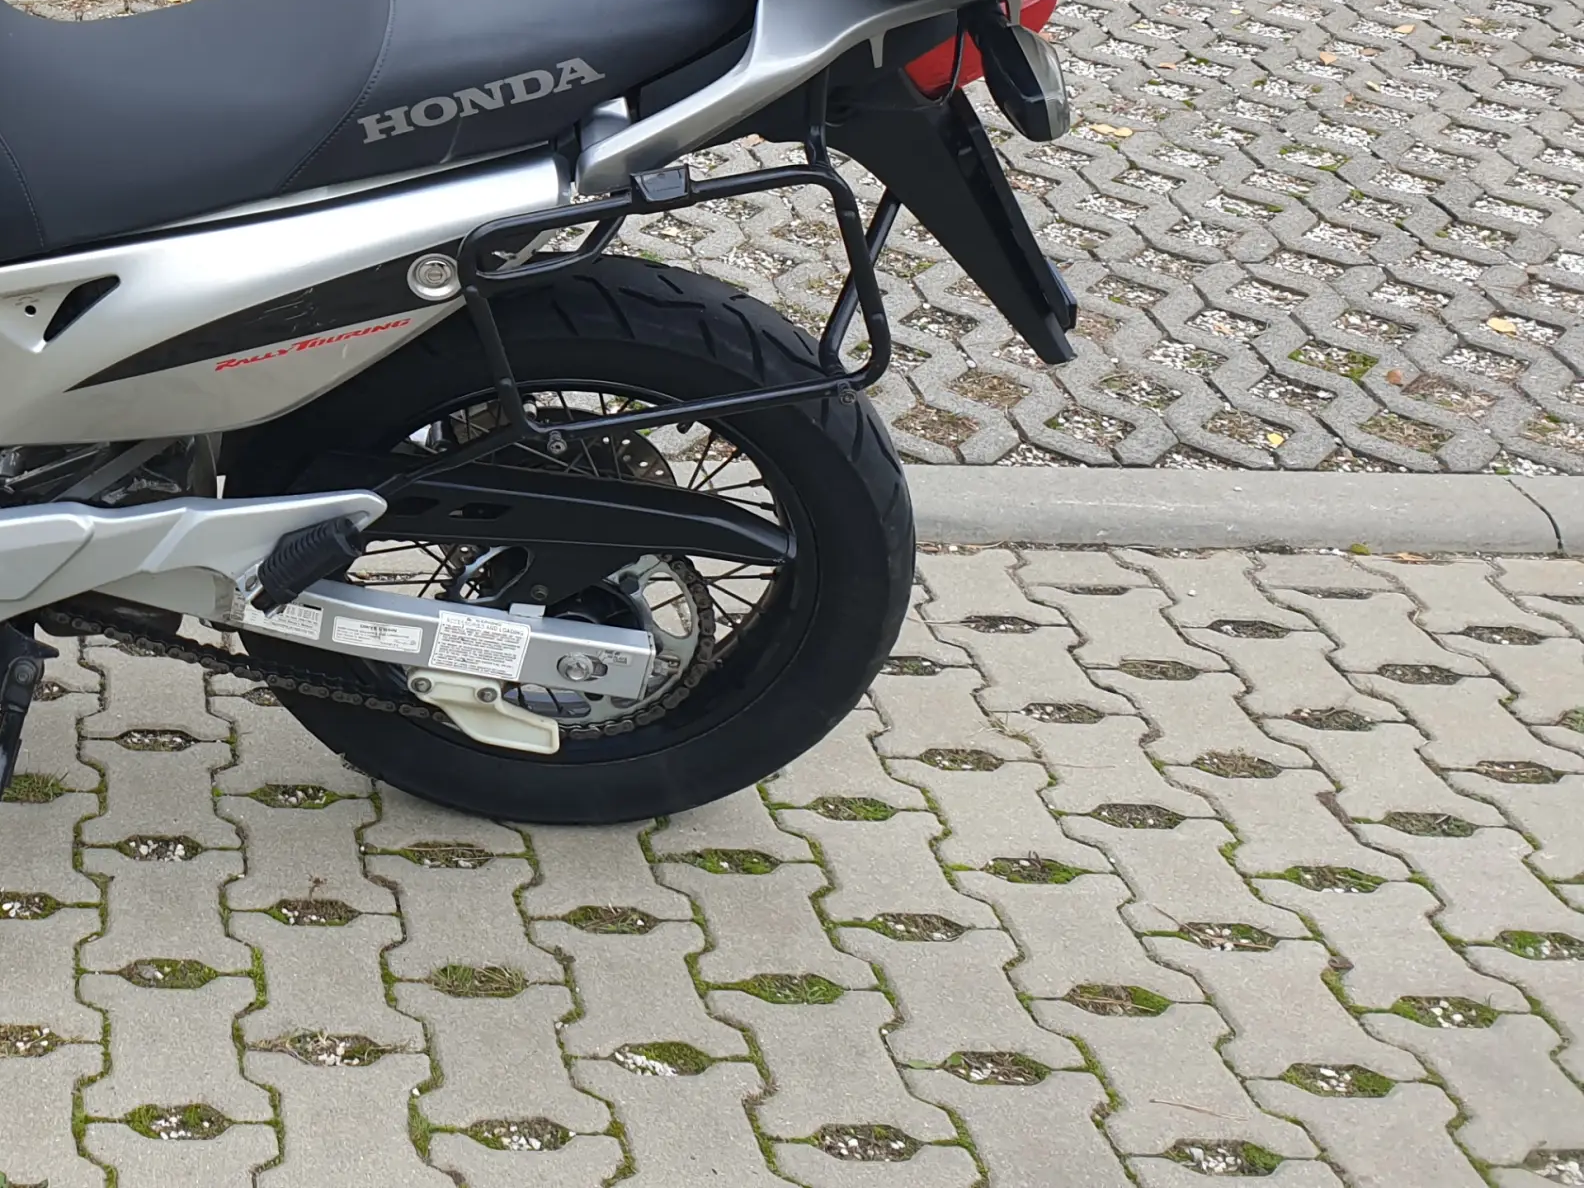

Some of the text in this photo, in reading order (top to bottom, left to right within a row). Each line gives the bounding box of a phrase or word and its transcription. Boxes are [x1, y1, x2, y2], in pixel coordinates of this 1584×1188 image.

[357, 57, 606, 144] HONDA
[214, 318, 412, 372] RALLY TOURING
